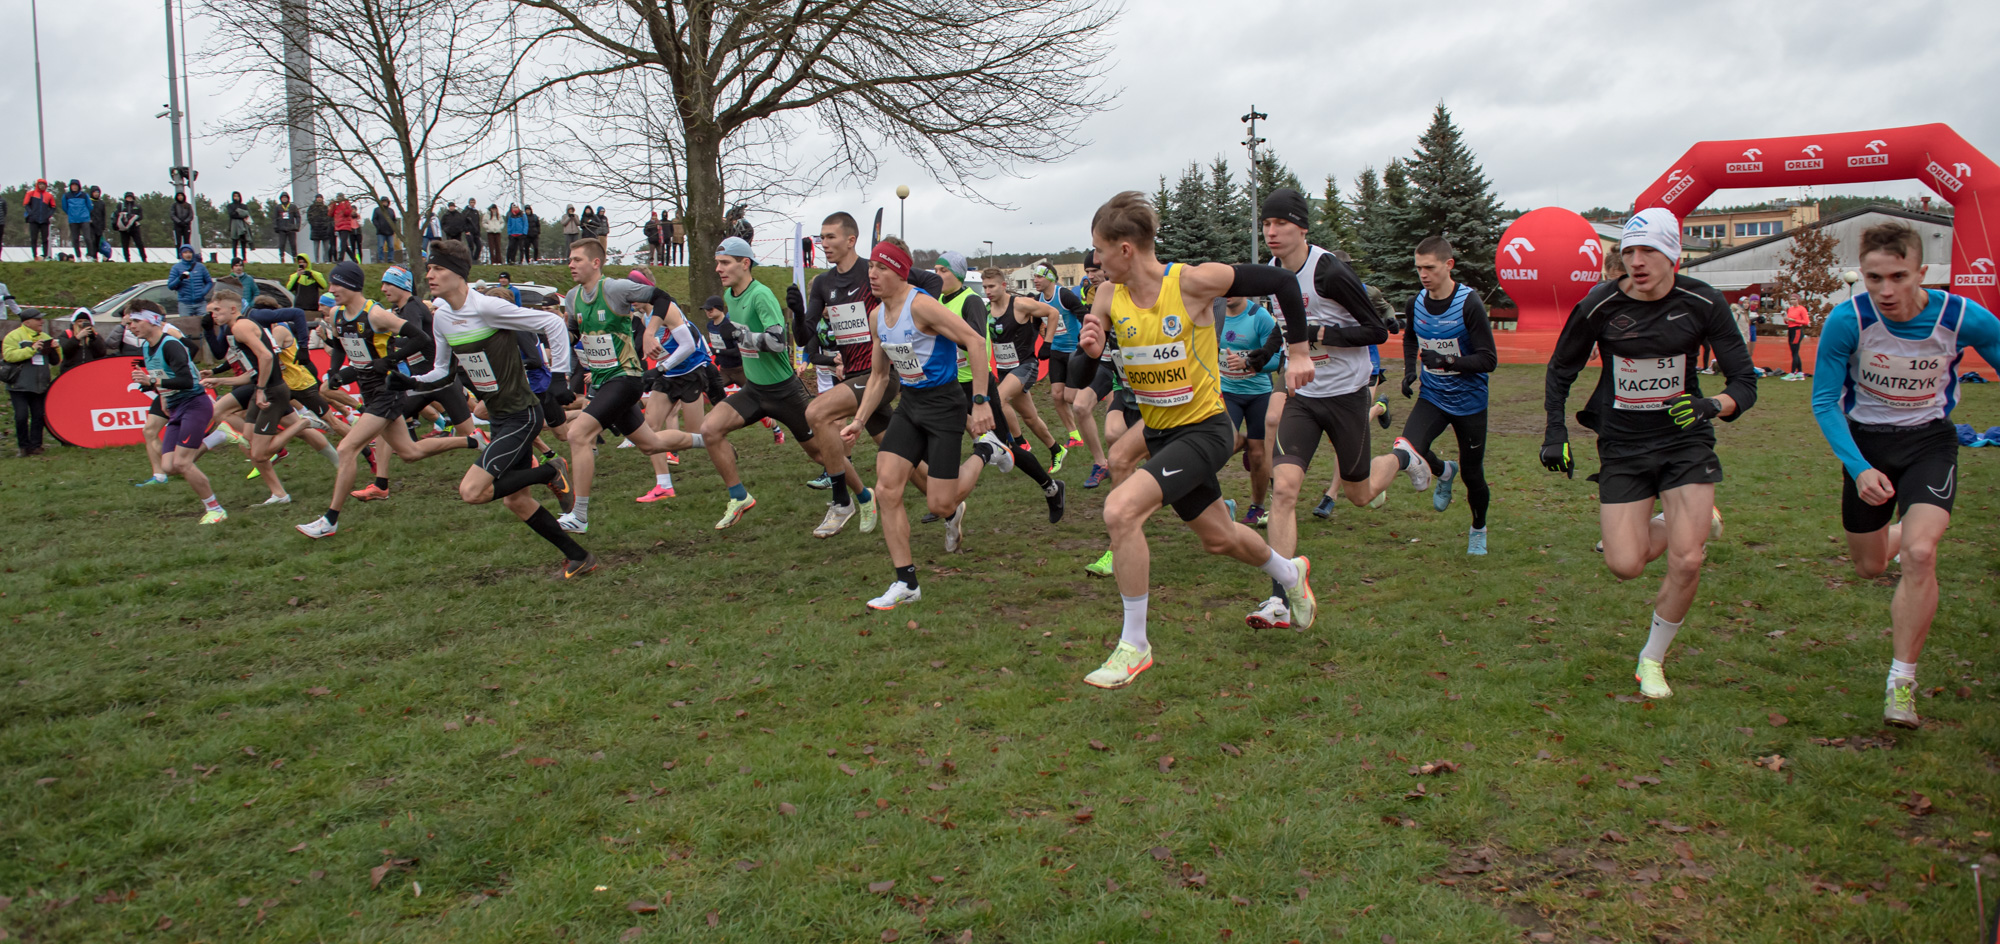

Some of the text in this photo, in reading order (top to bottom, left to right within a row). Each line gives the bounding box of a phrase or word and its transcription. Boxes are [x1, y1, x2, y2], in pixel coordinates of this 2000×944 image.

[1787, 160, 1821, 169] ORLEN
[1850, 156, 1885, 165] ORLEN
[1728, 163, 1760, 171] ORLEN
[1930, 165, 1959, 189] ORLEN
[1665, 177, 1691, 201] ORLEN
[1500, 269, 1538, 280] ORLEN
[1957, 276, 1992, 284] ORLEN
[850, 305, 855, 313] 9
[832, 318, 866, 330] WIECZOREK
[596, 336, 606, 344] 61
[1436, 341, 1454, 349] 204
[895, 346, 910, 354] 498
[1153, 346, 1179, 360] 466
[468, 354, 483, 363] 431
[1657, 358, 1675, 369] 51
[1869, 361, 1890, 369] ORLEN
[1909, 359, 1938, 370] 106
[1128, 366, 1187, 385] BOROWSKI
[1862, 369, 1937, 390] WIATRZYK
[1618, 376, 1680, 392] KACZOR
[97, 410, 149, 427] ORL
